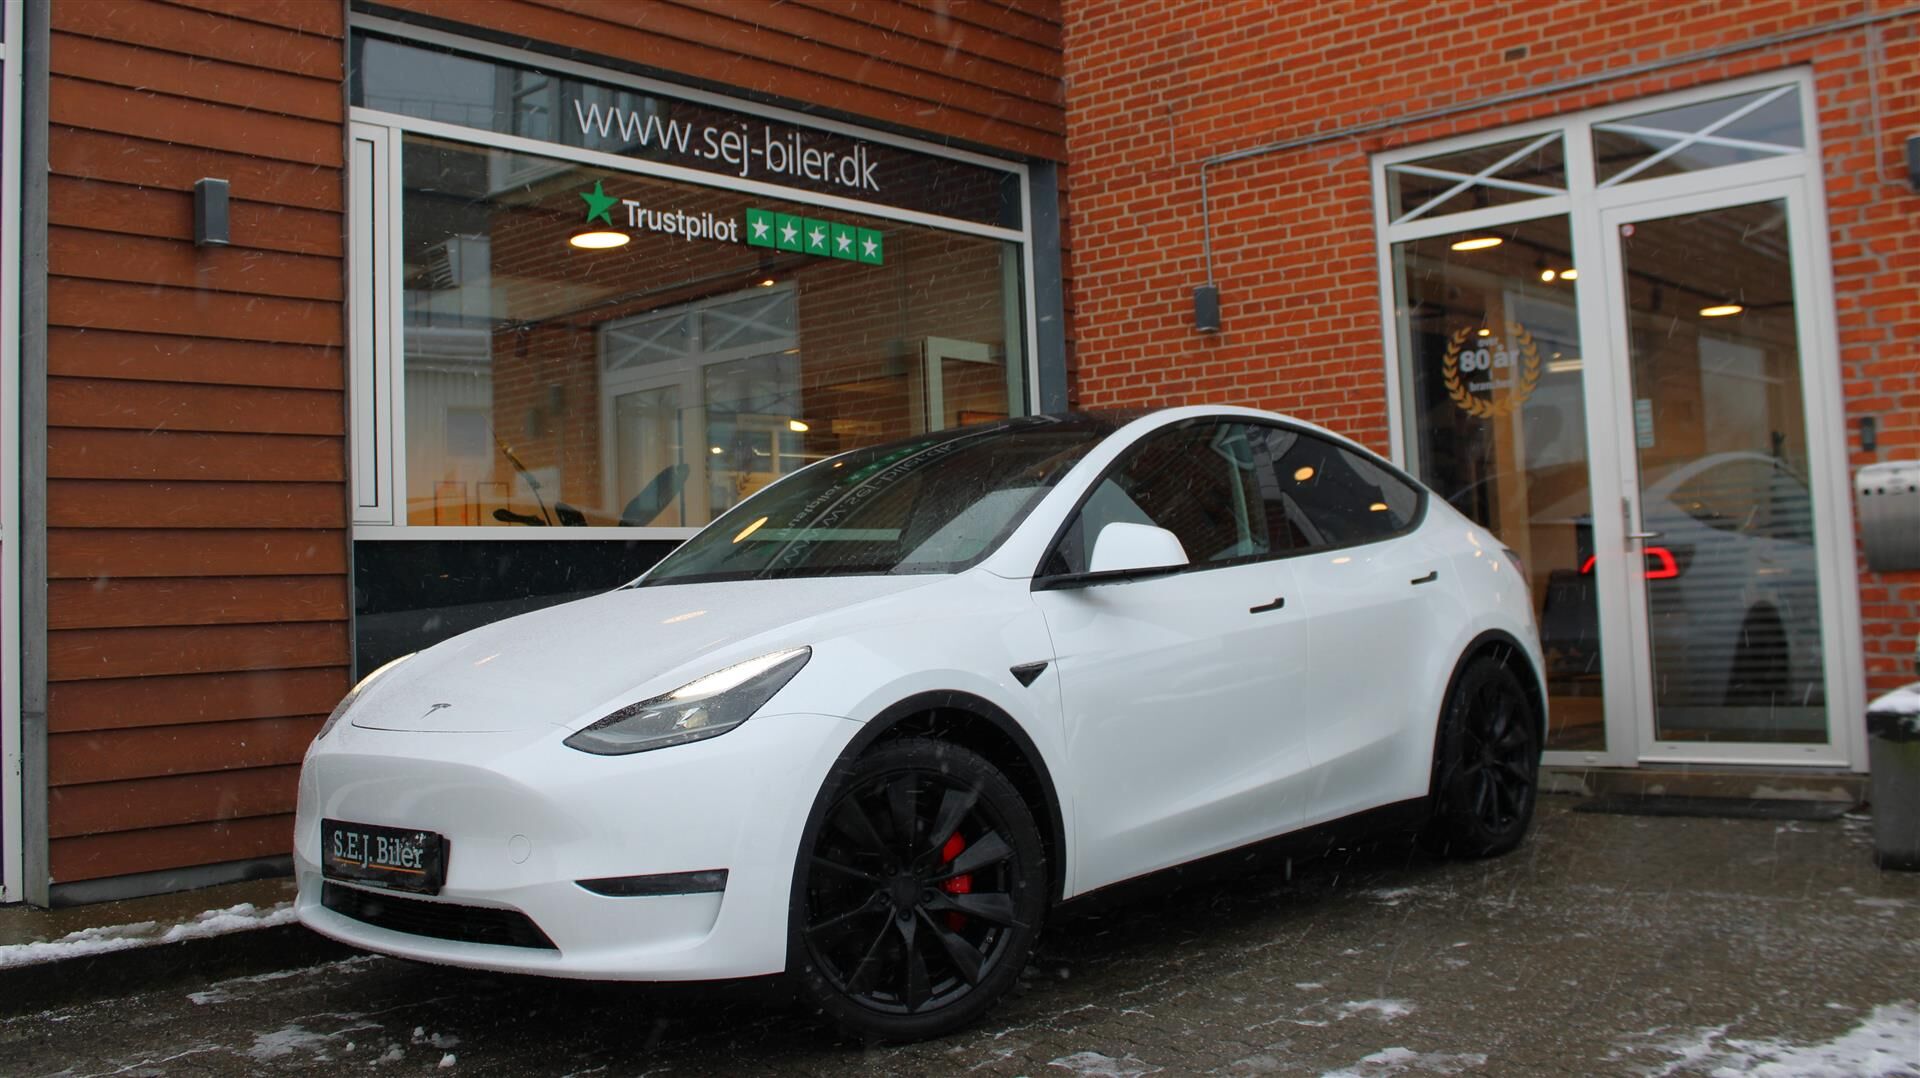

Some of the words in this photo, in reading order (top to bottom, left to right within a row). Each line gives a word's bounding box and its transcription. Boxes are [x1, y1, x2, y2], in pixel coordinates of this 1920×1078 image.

[574, 99, 880, 191] www.sej-biler.dk
[622, 199, 738, 243] Trustpilot
[1459, 348, 1490, 372] 80
[1493, 344, 1520, 368] år
[334, 830, 373, 868] S.E.J.
[377, 836, 424, 869] Biler
